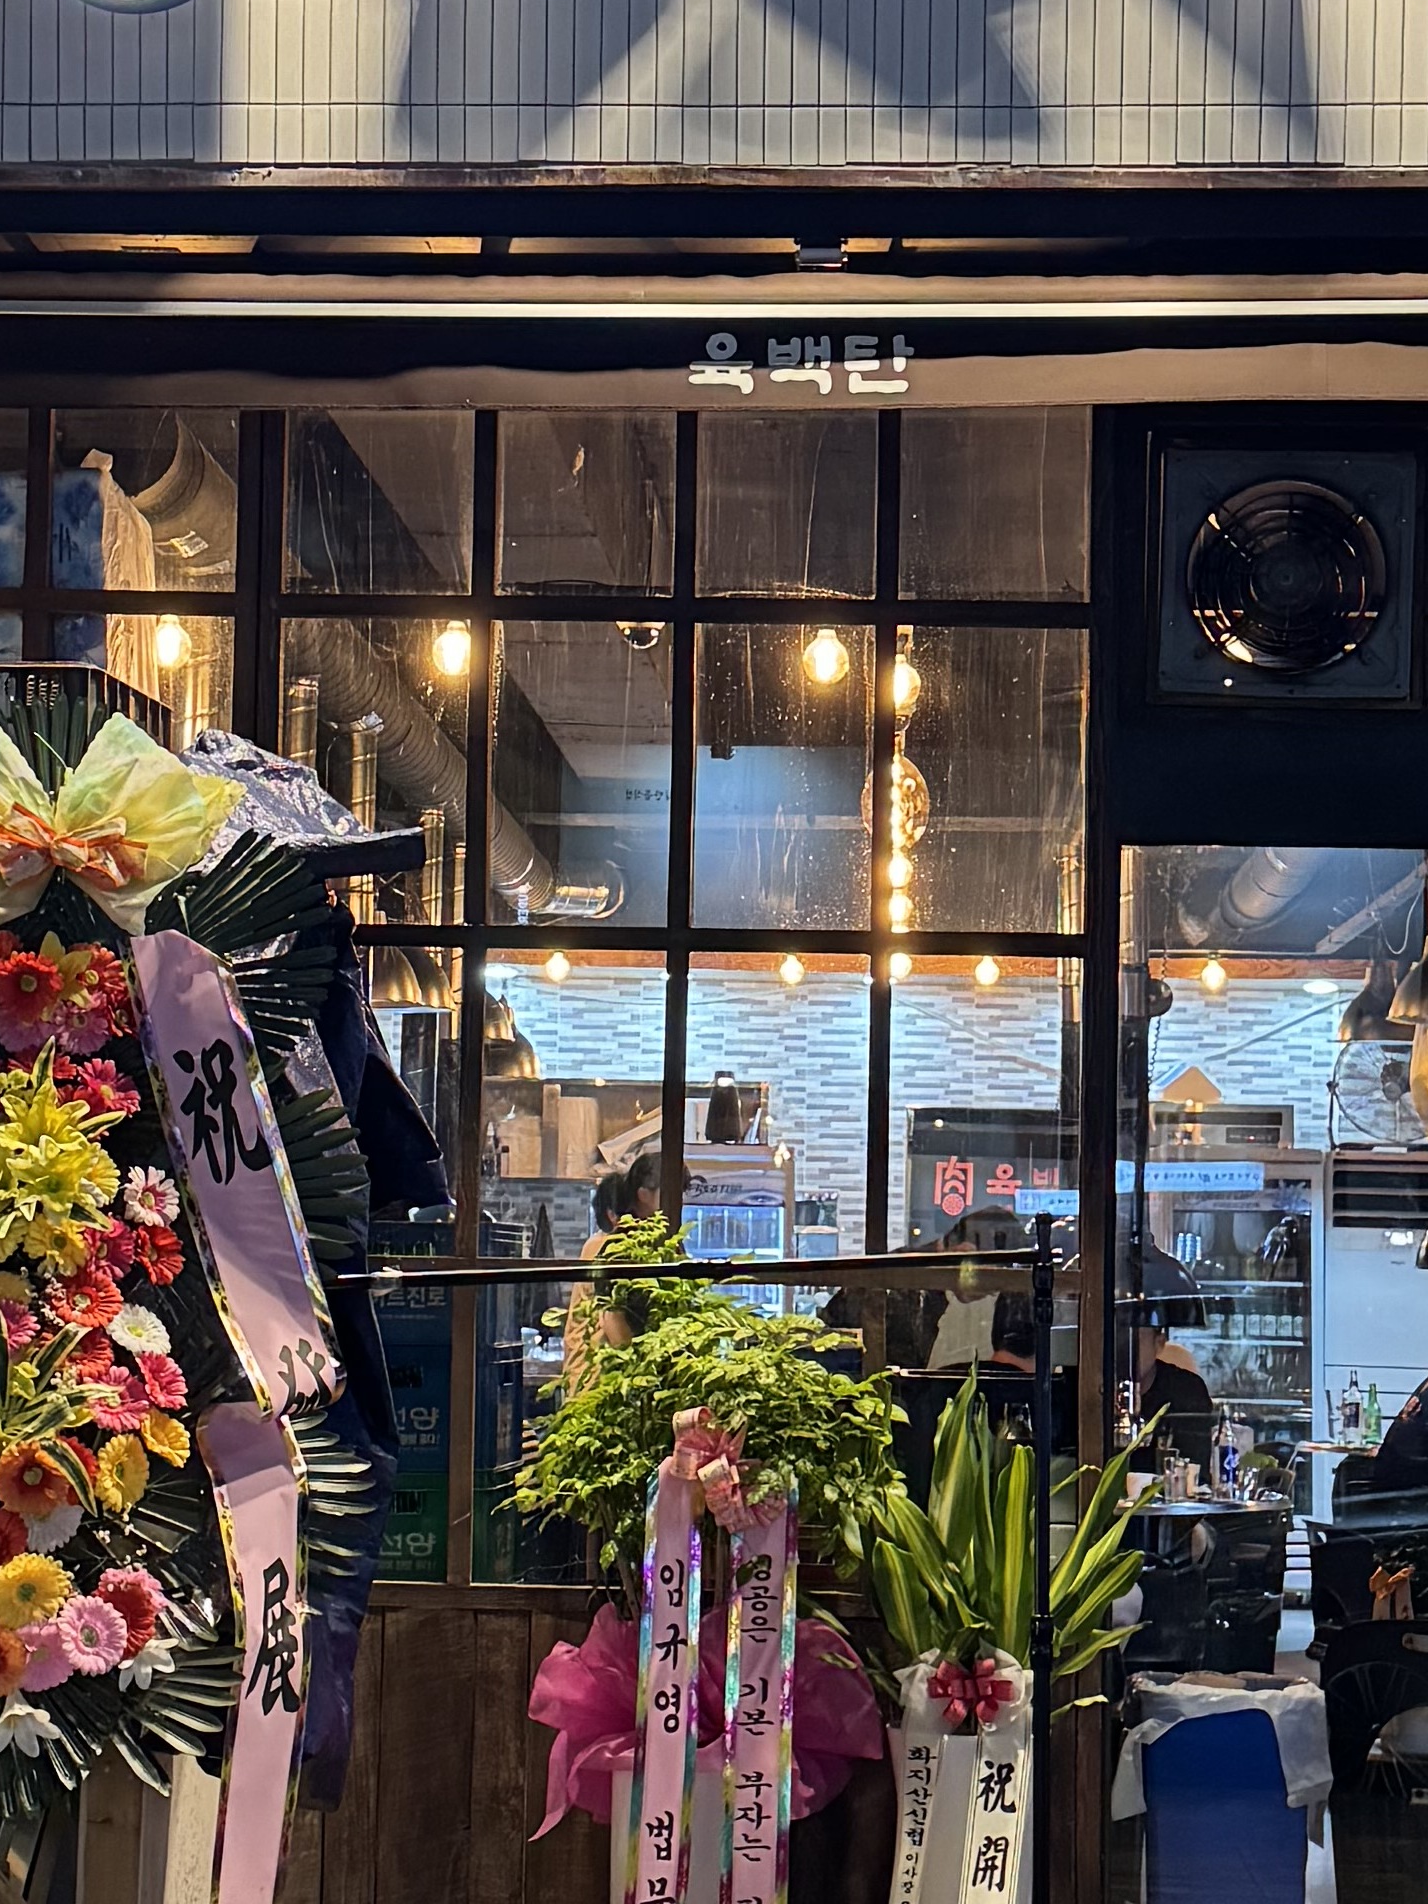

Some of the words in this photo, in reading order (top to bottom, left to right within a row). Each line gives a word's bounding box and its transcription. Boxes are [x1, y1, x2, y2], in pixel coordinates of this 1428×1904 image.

[688, 332, 914, 395] 육백탄
[655, 1558, 688, 1734] 임규영
[736, 1677, 774, 1735] 기본
[733, 1771, 772, 1862] 부자는
